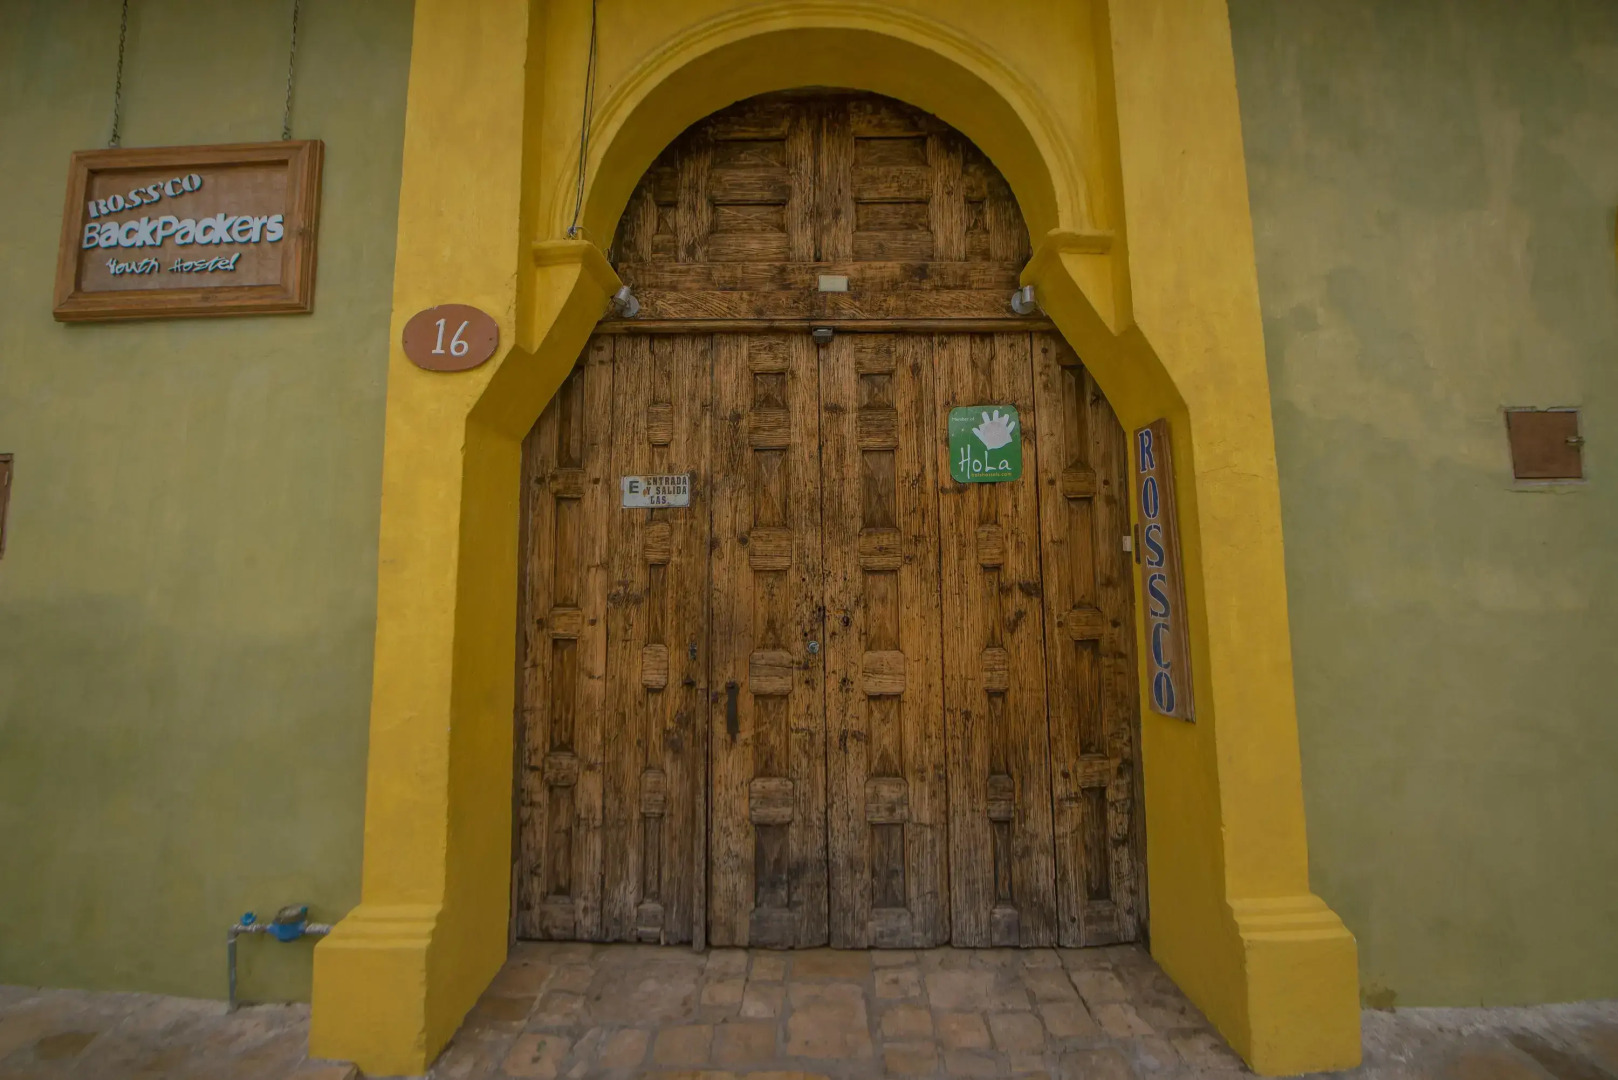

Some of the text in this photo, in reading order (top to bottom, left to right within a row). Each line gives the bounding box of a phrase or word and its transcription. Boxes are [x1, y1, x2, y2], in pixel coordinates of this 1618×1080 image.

[82, 212, 284, 249] BackPackers
[106, 252, 241, 275] Youth Hostel
[431, 318, 469, 357] 16
[629, 480, 640, 494] E
[646, 476, 687, 486] ENTRADA
[646, 486, 687, 495] Y SALIDA
[1138, 428, 1176, 713] ROSSCO
